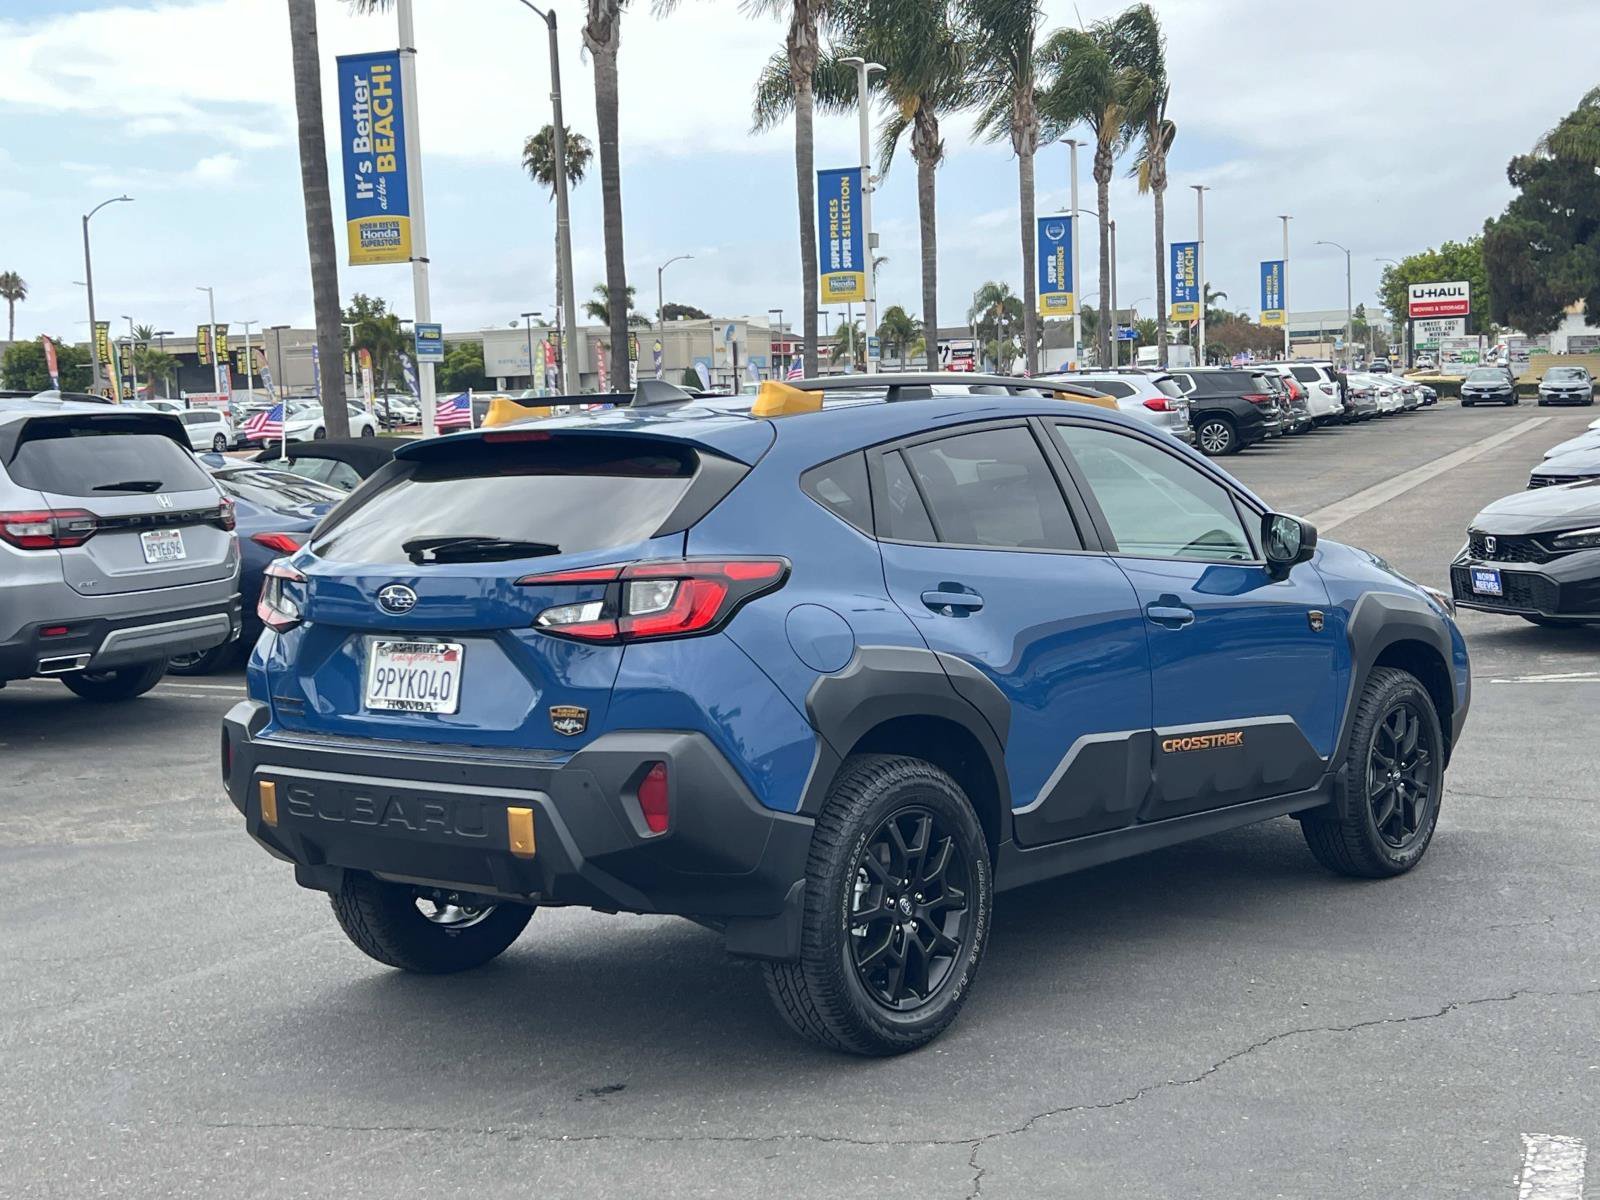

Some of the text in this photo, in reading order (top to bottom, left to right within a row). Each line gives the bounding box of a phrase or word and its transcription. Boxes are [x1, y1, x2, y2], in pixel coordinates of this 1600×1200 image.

[371, 64, 397, 173] BEACH!
[352, 75, 374, 200] It's Better
[362, 229, 398, 239] Honda
[830, 199, 840, 269] SUPER PRICES
[842, 177, 852, 269] SUPER SELECTION
[360, 237, 401, 248] SUPERSTORE
[1047, 254, 1056, 283] SUPER
[1175, 250, 1184, 297] It's Better
[1185, 247, 1195, 287] BEACH!
[1413, 287, 1465, 298] U-HAUL
[1476, 572, 1495, 581] NORM
[1476, 581, 1499, 590] REEVES
[374, 667, 451, 701] 9PYK040
[386, 699, 434, 711] HONDA
[1162, 731, 1244, 753] CROSSTREK
[286, 784, 489, 838] SUBARU
